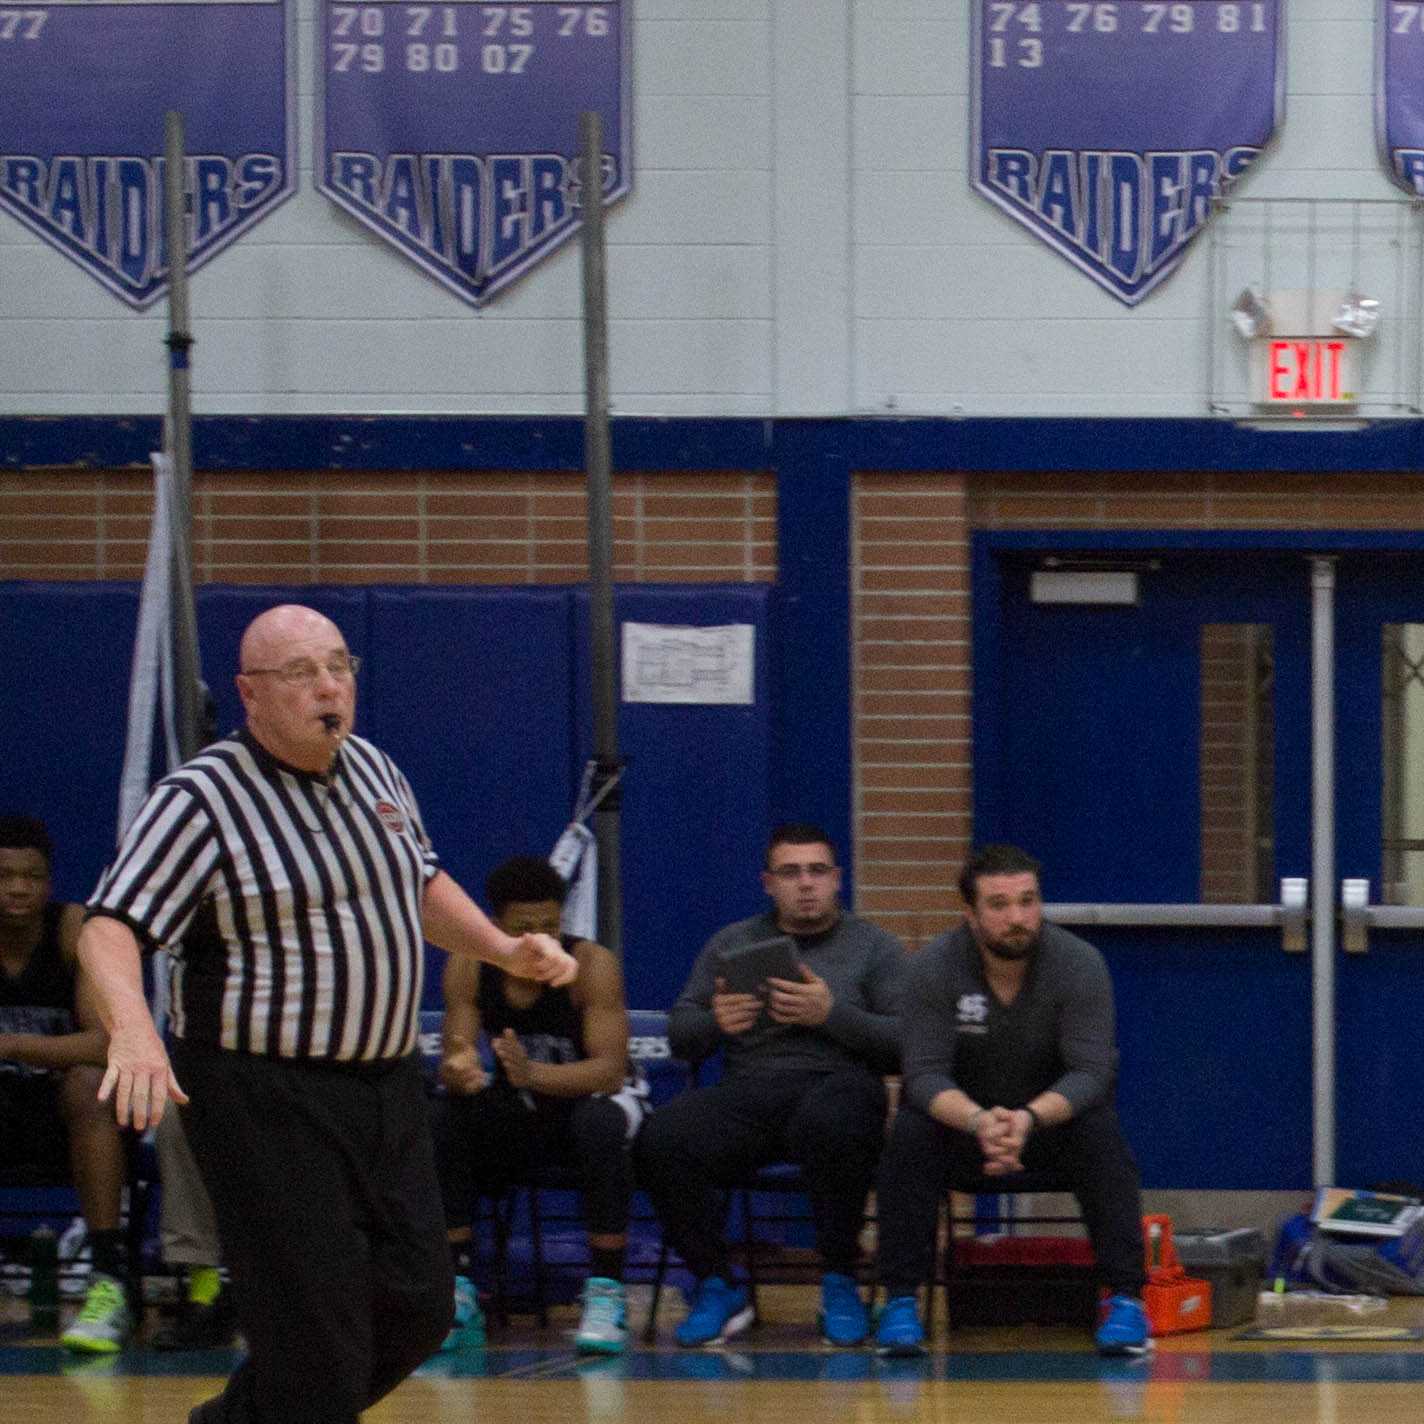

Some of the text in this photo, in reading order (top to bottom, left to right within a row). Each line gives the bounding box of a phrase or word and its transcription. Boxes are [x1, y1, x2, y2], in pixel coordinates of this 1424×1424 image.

[332, 7, 609, 37] 70 71 75 76
[990, 3, 1266, 34] 74 76 79 81
[332, 43, 534, 74] 79 80 07
[986, 38, 1044, 69] 13
[1269, 342, 1345, 399] EXIT
